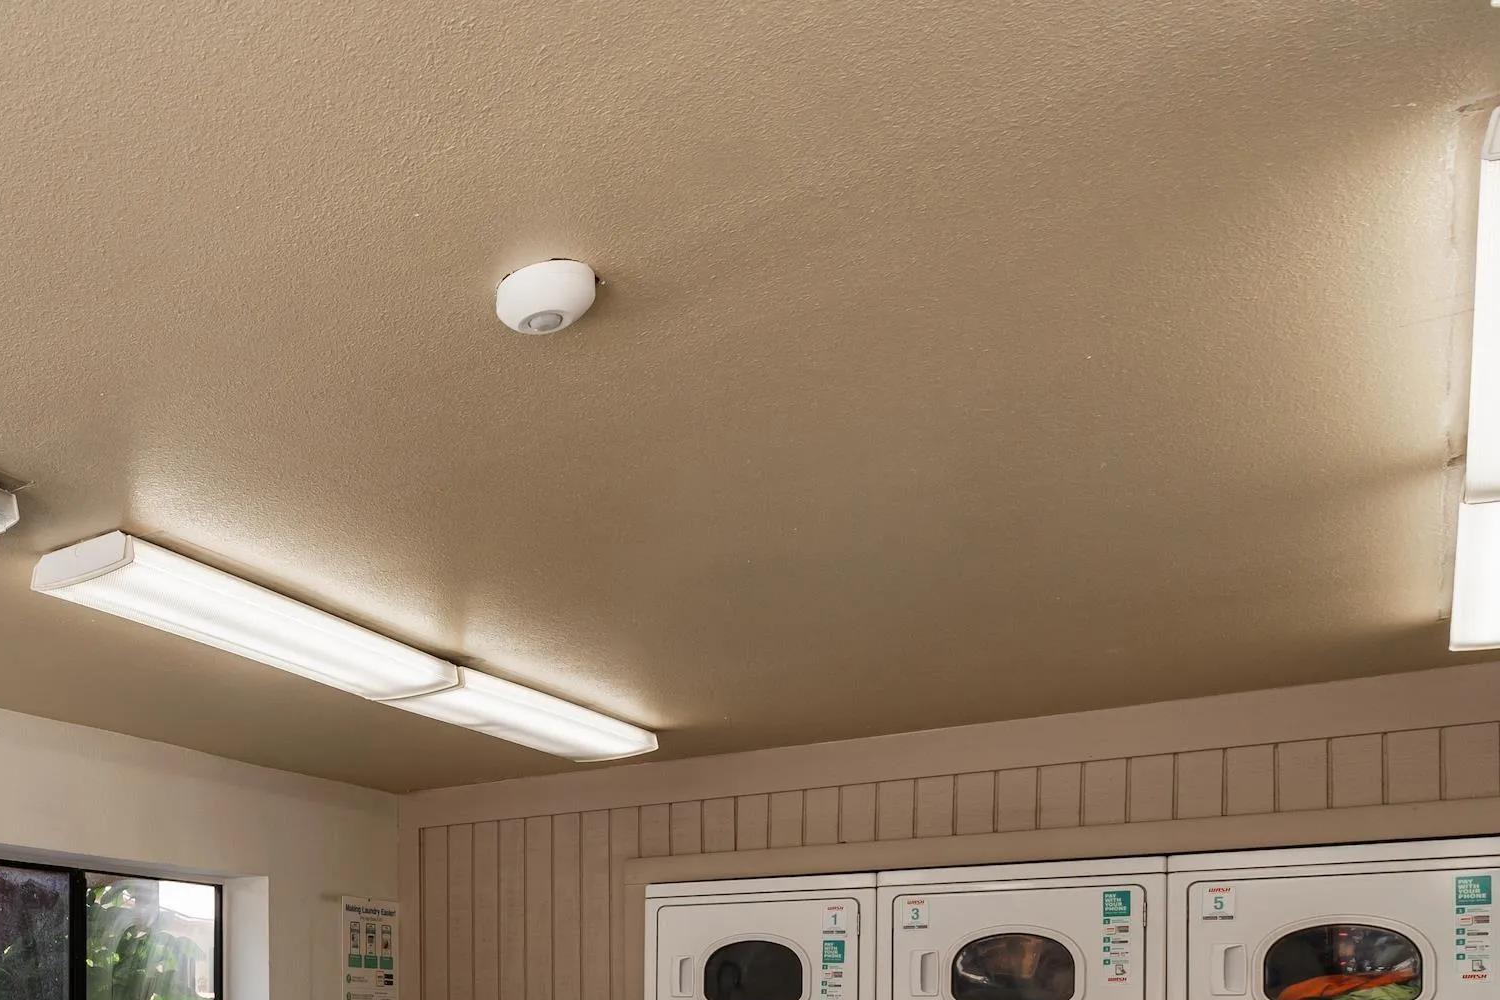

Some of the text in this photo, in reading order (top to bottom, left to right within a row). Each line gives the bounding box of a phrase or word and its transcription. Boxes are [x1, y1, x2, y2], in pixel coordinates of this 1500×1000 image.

[1214, 896, 1224, 910] 5
[832, 914, 837, 925] 1
[911, 908, 920, 920] 3
